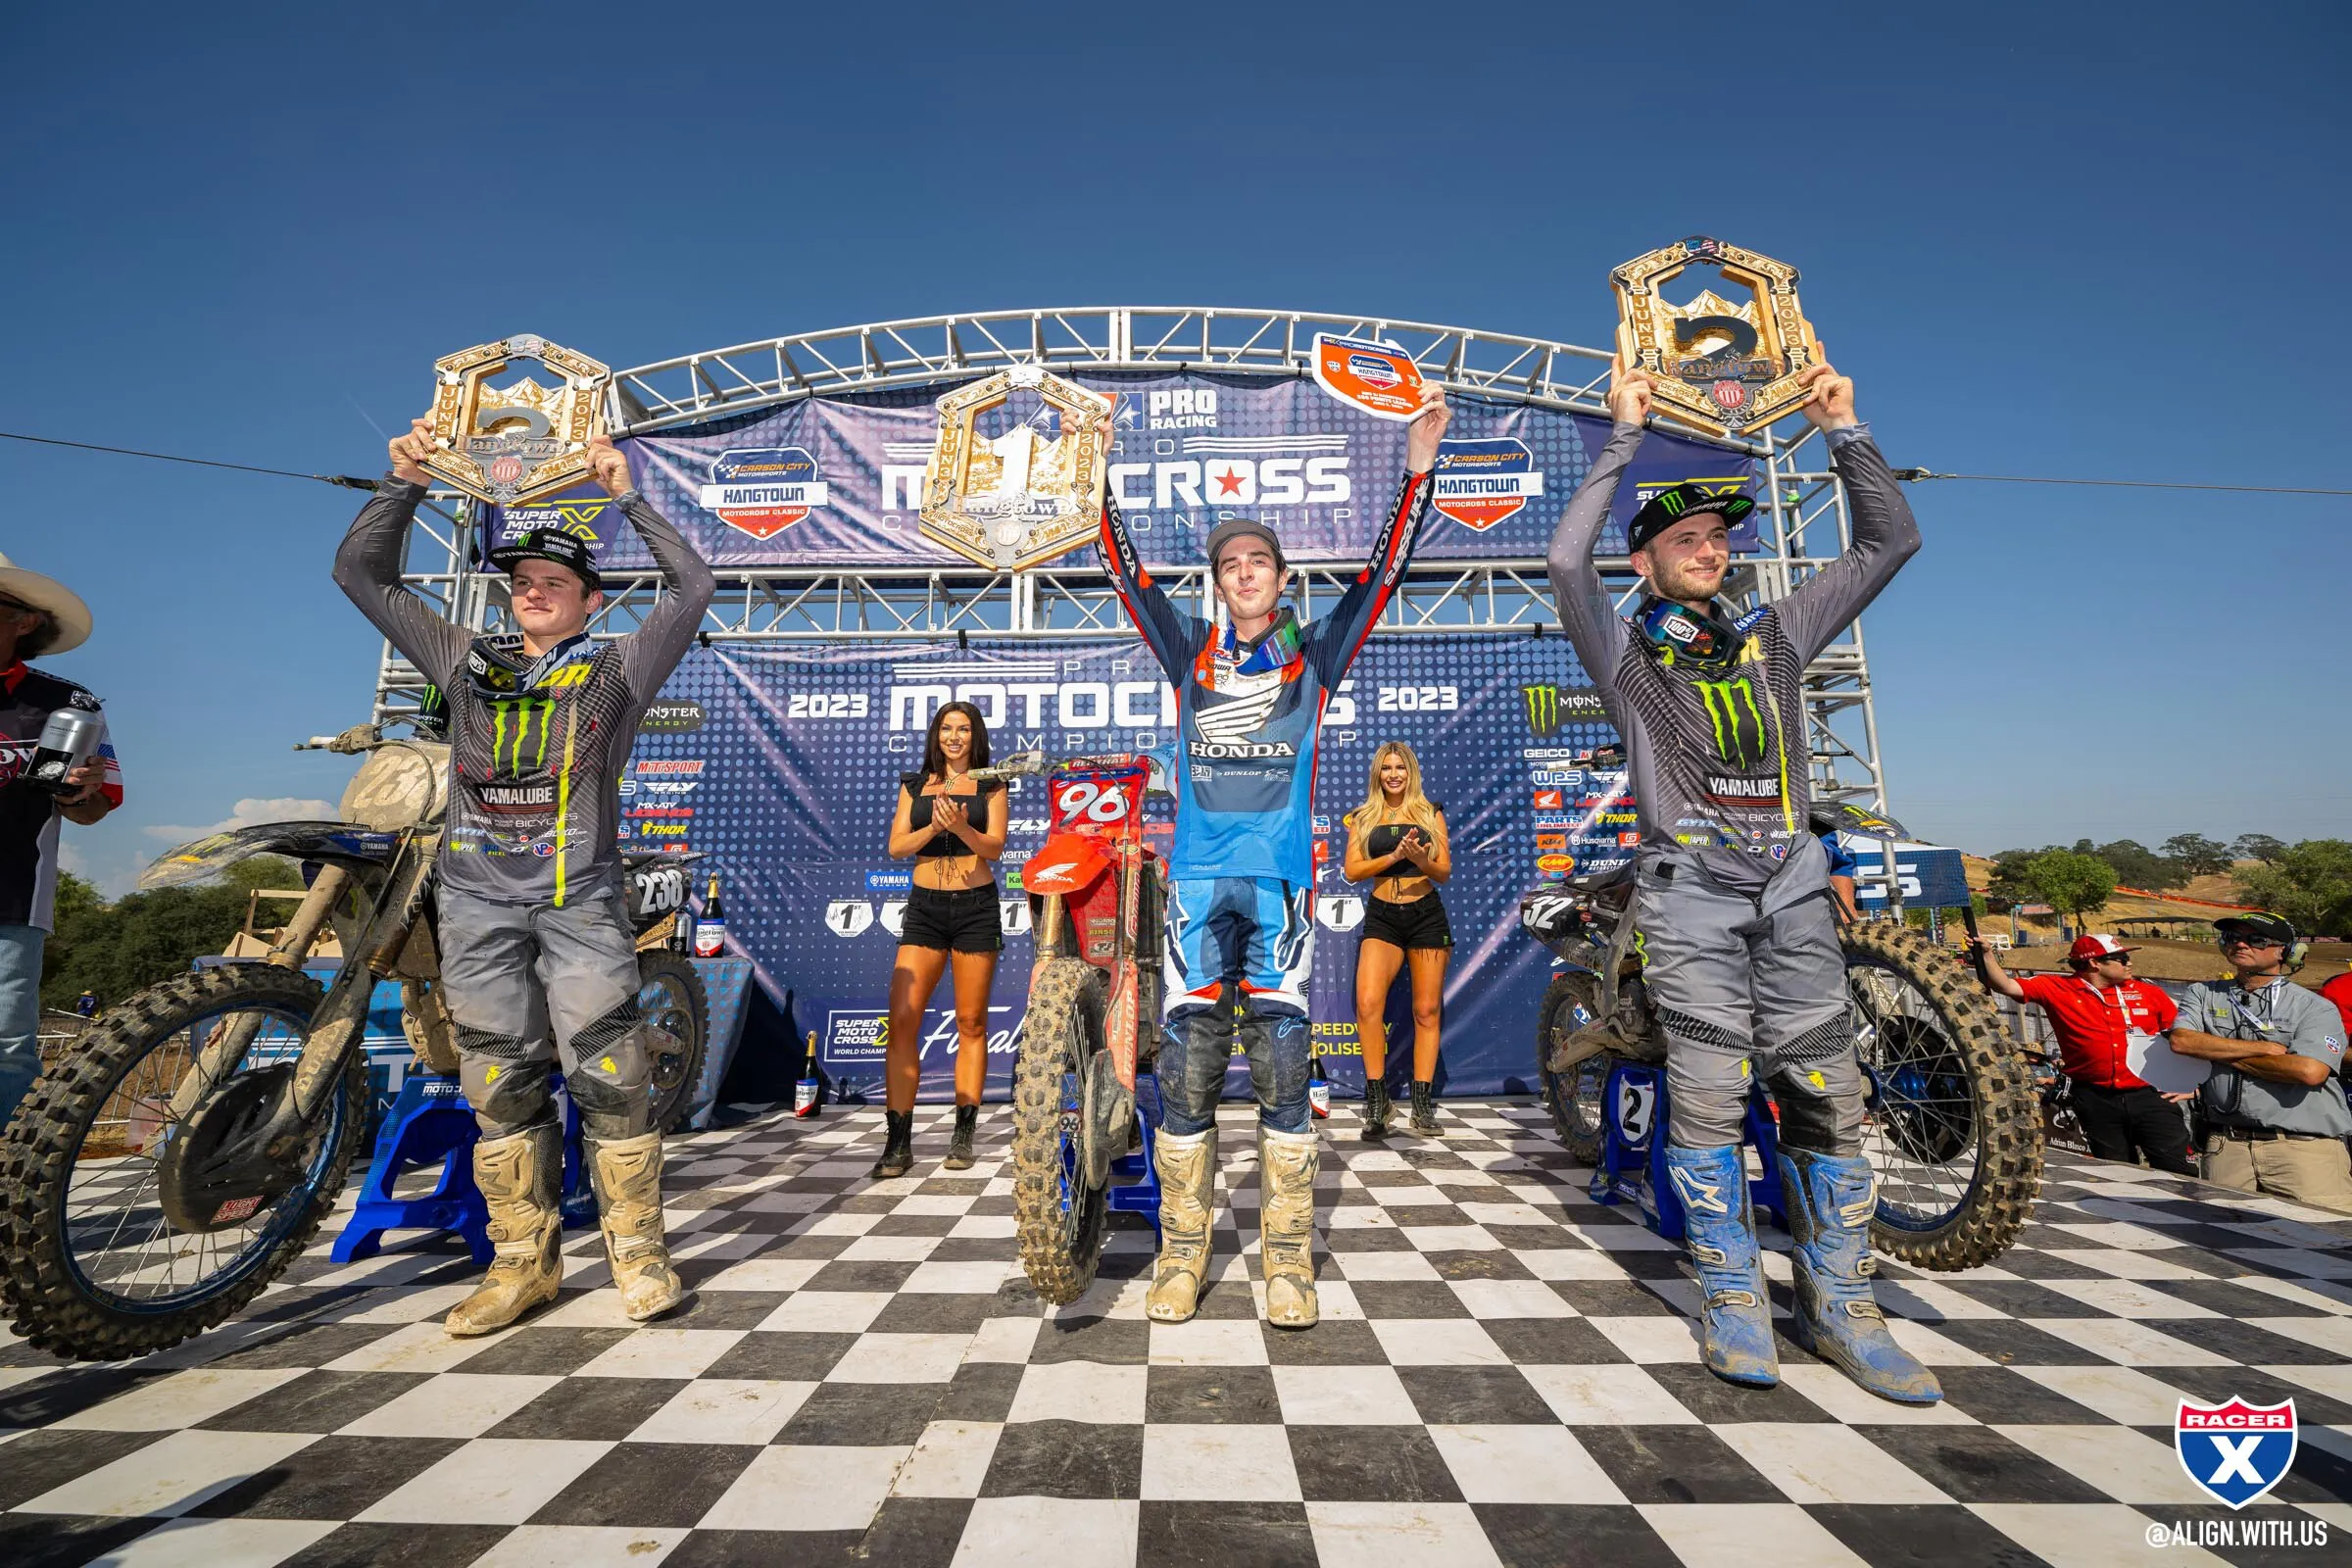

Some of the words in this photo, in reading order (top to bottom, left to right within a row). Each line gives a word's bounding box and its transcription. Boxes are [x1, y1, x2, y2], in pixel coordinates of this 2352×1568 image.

[1779, 296, 1800, 344] 2023
[1151, 390, 1217, 416] PRO
[572, 393, 590, 440] 2023
[1151, 416, 1217, 430] RACING
[1078, 433, 1093, 482] 2023
[1500, 452, 1527, 461] CITY
[740, 464, 784, 472] CARSON
[785, 463, 811, 471] CITY
[1438, 477, 1520, 494] HANGTOWN
[723, 487, 805, 504] HANGTOWN
[503, 511, 562, 520] SUPER
[772, 508, 806, 516] CLASSIC
[1369, 478, 1408, 571] HONDA
[1106, 494, 1137, 578] HONDA
[1668, 618, 1693, 639] 100%
[788, 694, 869, 718] 2023
[1378, 686, 1458, 710] 2023
[1559, 694, 1602, 709] MONS
[1189, 741, 1296, 760] HONDA
[1524, 749, 1570, 758] GEICO
[1532, 769, 1583, 786] WPS
[1585, 790, 1627, 799] MX-ATV
[1709, 776, 1779, 797] YAMALUBE
[479, 786, 553, 806] YAMALUBE
[1058, 782, 1133, 828] 96
[515, 812, 578, 828] BICYCLES
[1536, 815, 1584, 824] PARTS
[1605, 813, 1639, 823] THOR
[651, 825, 688, 835] THOR
[1581, 836, 1617, 846] Husqvarna
[1540, 858, 1572, 867] FMF
[879, 875, 909, 884] YAMAHA
[635, 868, 684, 915] 238
[835, 1019, 880, 1028] SUPER
[837, 1027, 878, 1036] MOTO
[1311, 1022, 1393, 1036] PEEDY
[833, 1036, 878, 1045] CROSS
[1622, 1087, 1642, 1135] 2
[1060, 1114, 1080, 1131] 96
[2049, 1137, 2067, 1149] Adrian
[2067, 1140, 2086, 1152] Blanco
